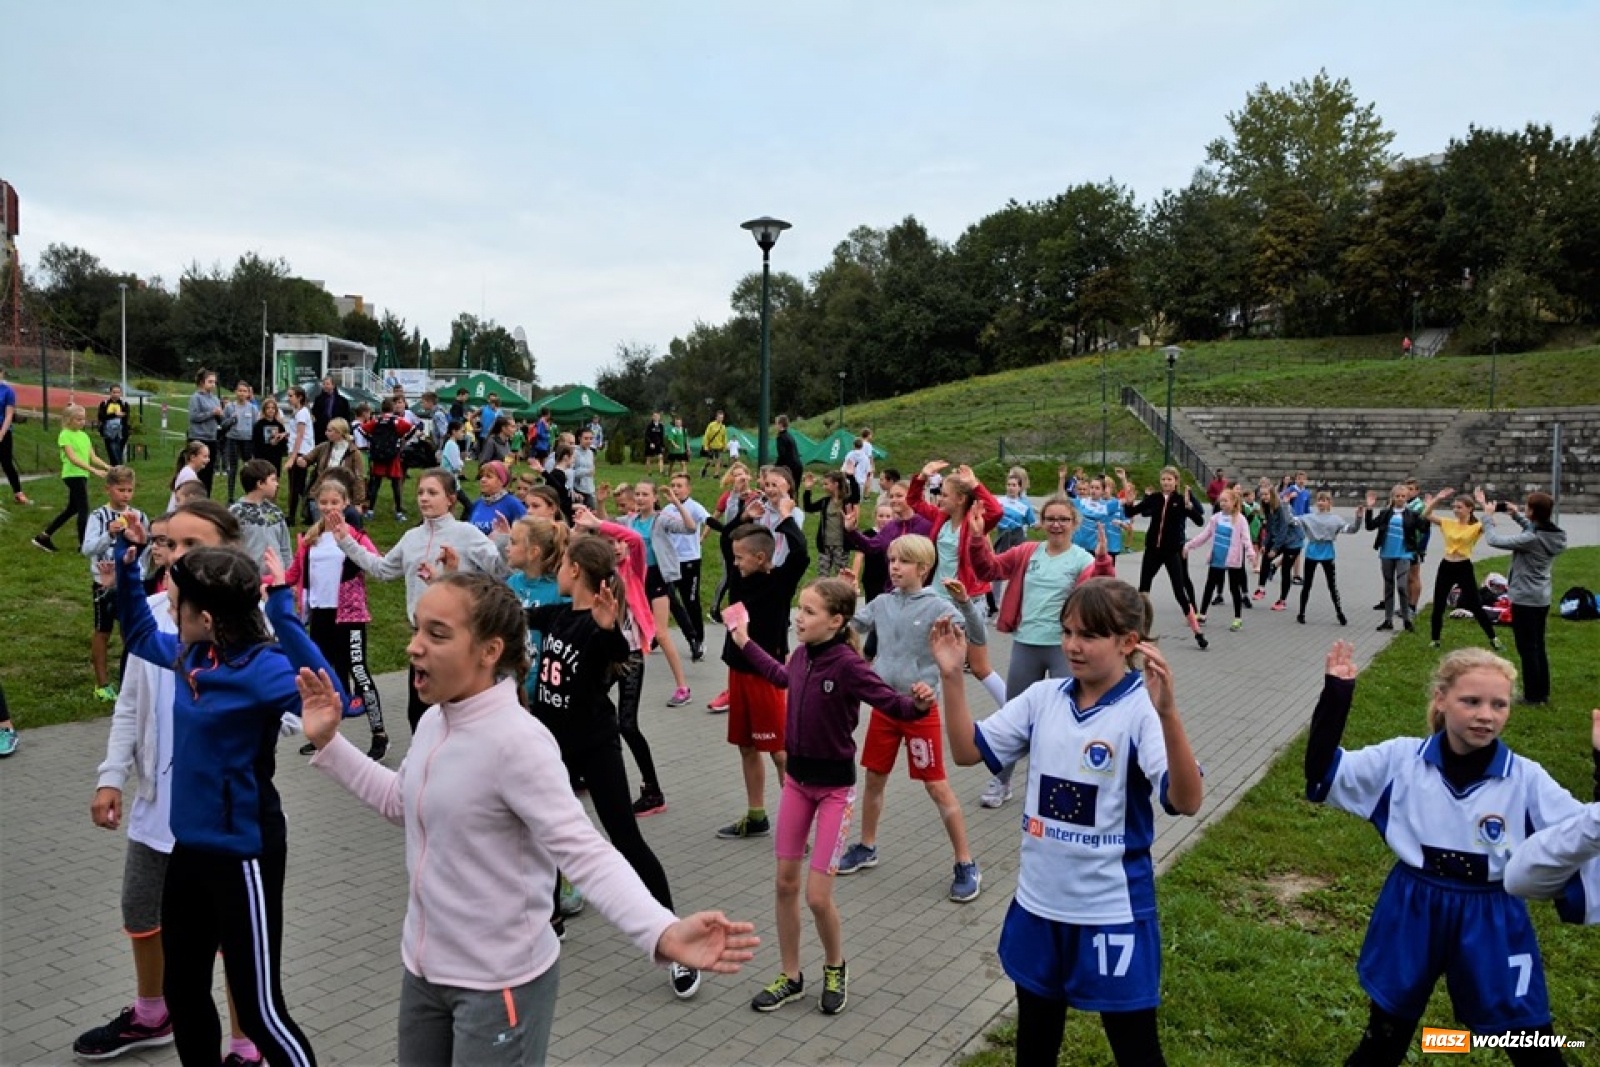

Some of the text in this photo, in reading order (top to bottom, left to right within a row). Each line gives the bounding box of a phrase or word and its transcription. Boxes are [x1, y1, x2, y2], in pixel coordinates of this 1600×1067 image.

[349, 629, 363, 663] NEVER
[540, 656, 563, 687] 36
[909, 737, 929, 769] 9
[1044, 827, 1100, 848] interreg
[1092, 932, 1135, 976] 17
[1508, 953, 1533, 998] 7
